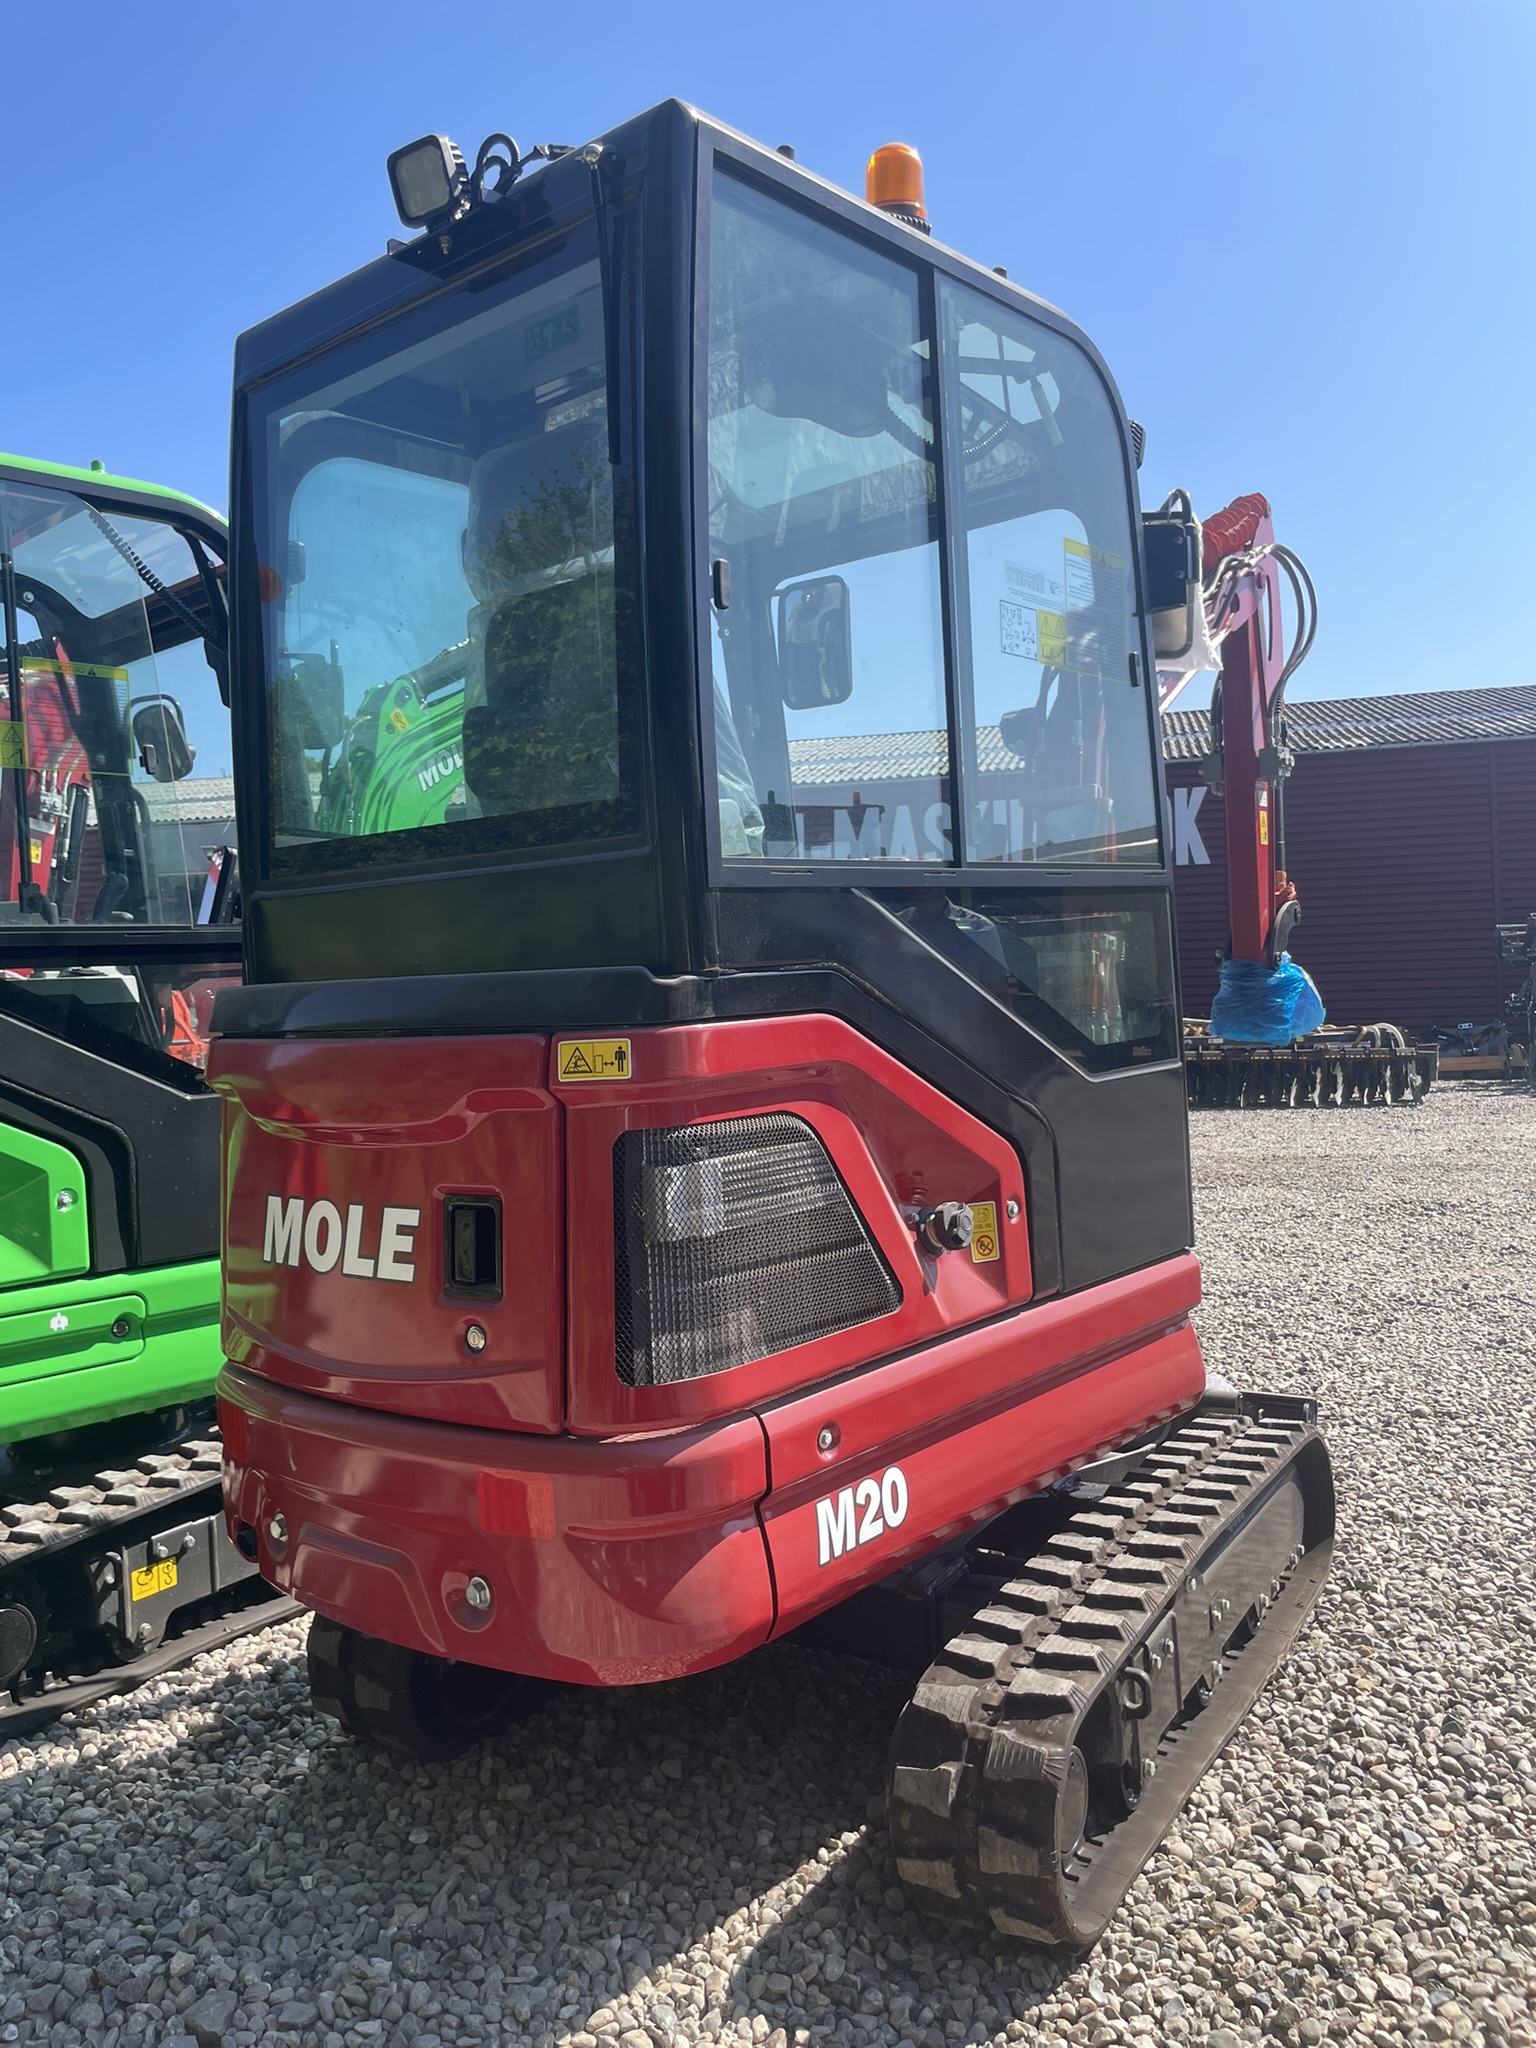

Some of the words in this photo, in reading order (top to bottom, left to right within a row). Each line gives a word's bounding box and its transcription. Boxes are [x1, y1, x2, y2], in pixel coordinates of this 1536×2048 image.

[416, 744, 463, 792] MOL
[262, 1194, 421, 1283] MOLE
[816, 1466, 908, 1566] M20
